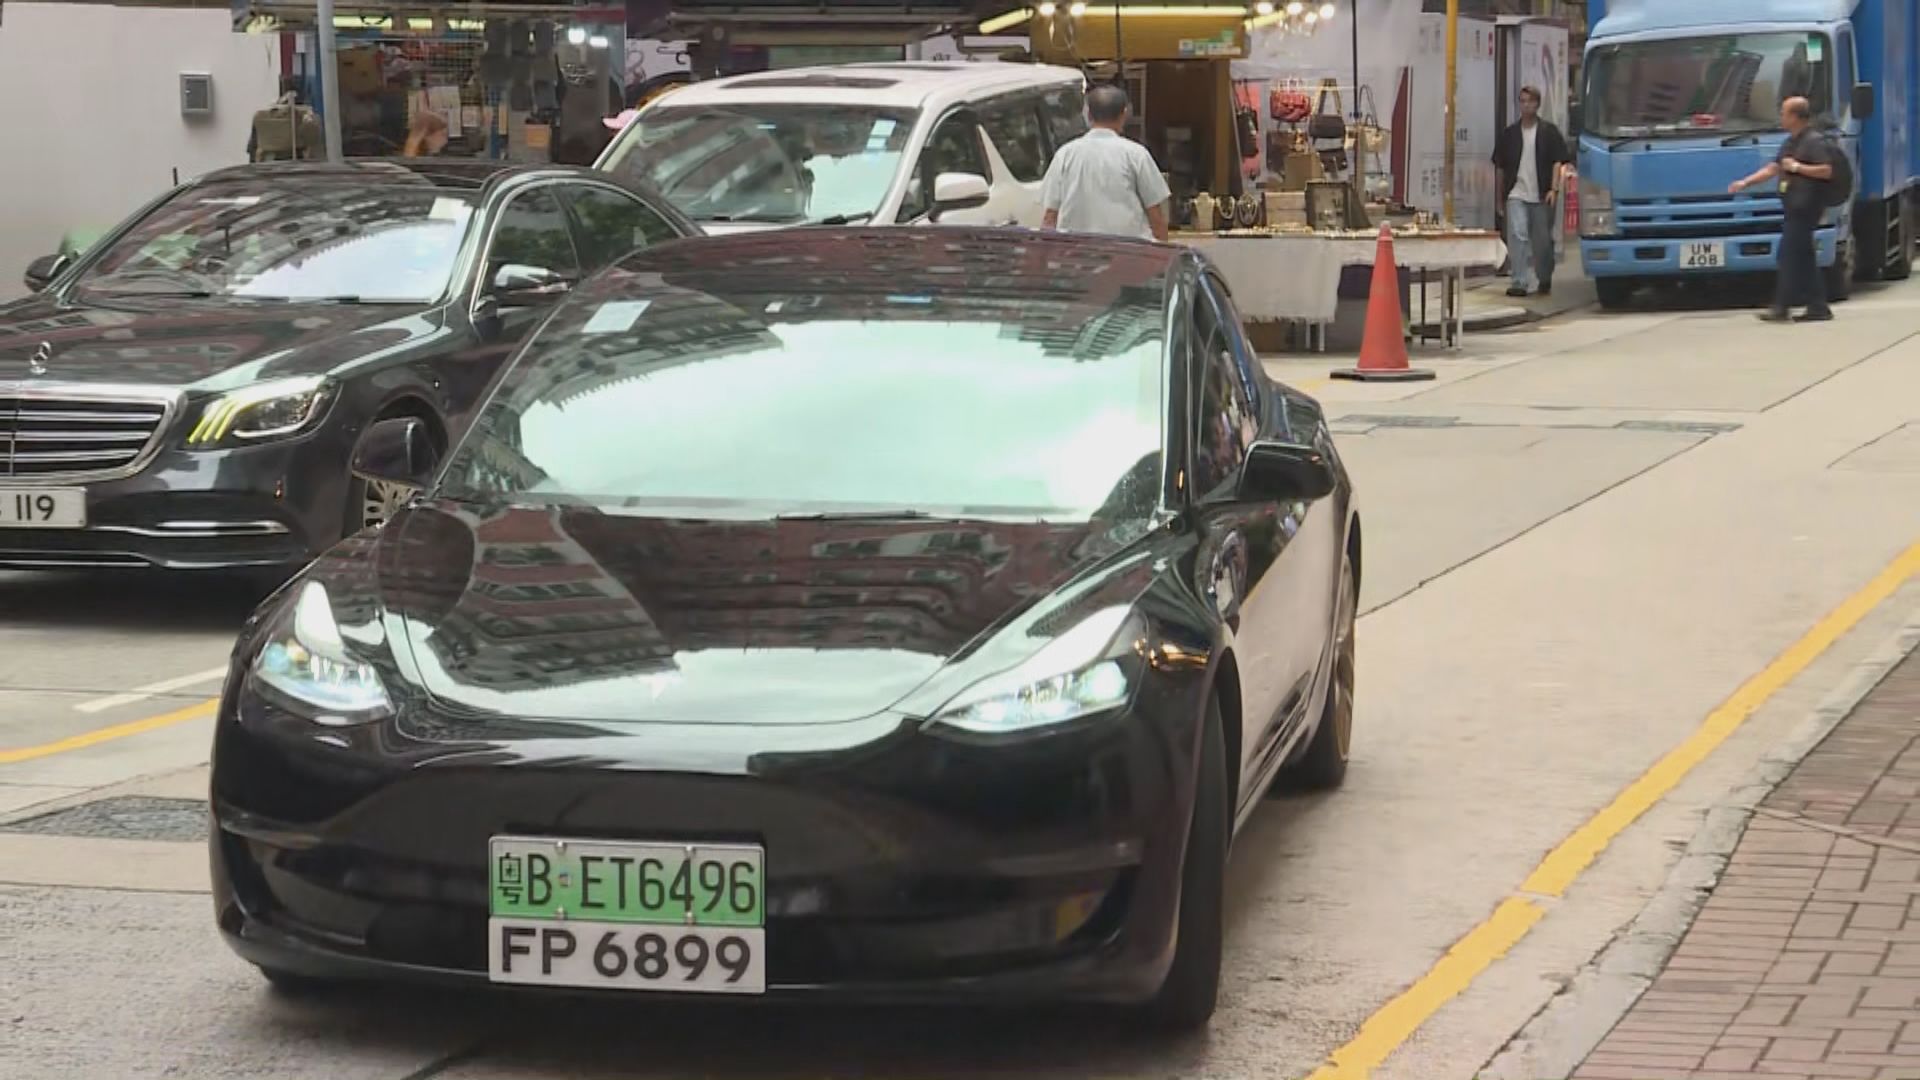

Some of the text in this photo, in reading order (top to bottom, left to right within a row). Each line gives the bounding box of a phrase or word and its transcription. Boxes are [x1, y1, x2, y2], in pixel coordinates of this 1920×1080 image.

[1691, 243, 1712, 255] UW
[16, 494, 55, 521] 119
[580, 856, 756, 914] ET6496
[502, 926, 751, 983] FP 6899
